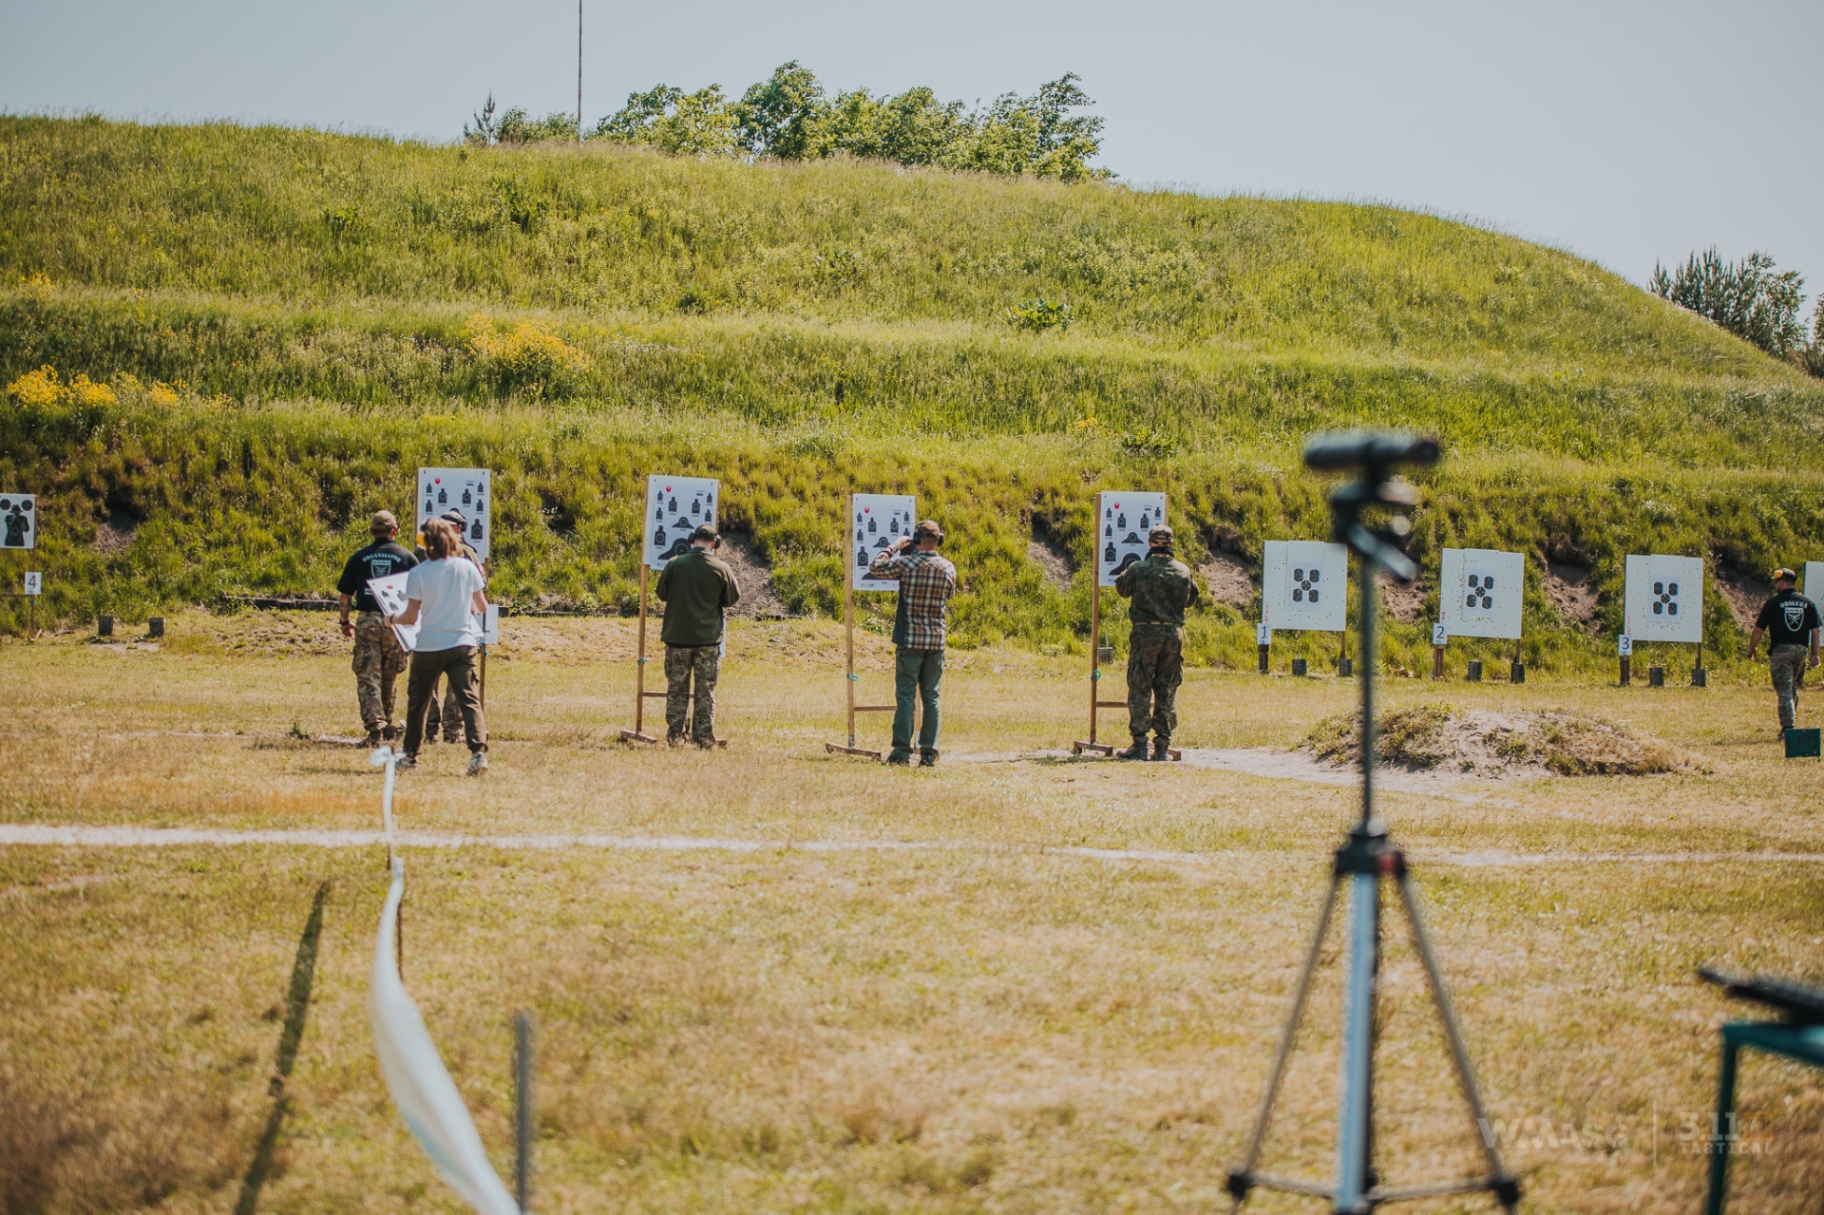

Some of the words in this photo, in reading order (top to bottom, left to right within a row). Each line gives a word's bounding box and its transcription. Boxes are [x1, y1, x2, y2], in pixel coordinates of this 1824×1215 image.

[28, 575, 37, 588] 4
[1261, 626, 1268, 639] 1
[1436, 626, 1445, 639] 2
[1621, 637, 1630, 650] 3
